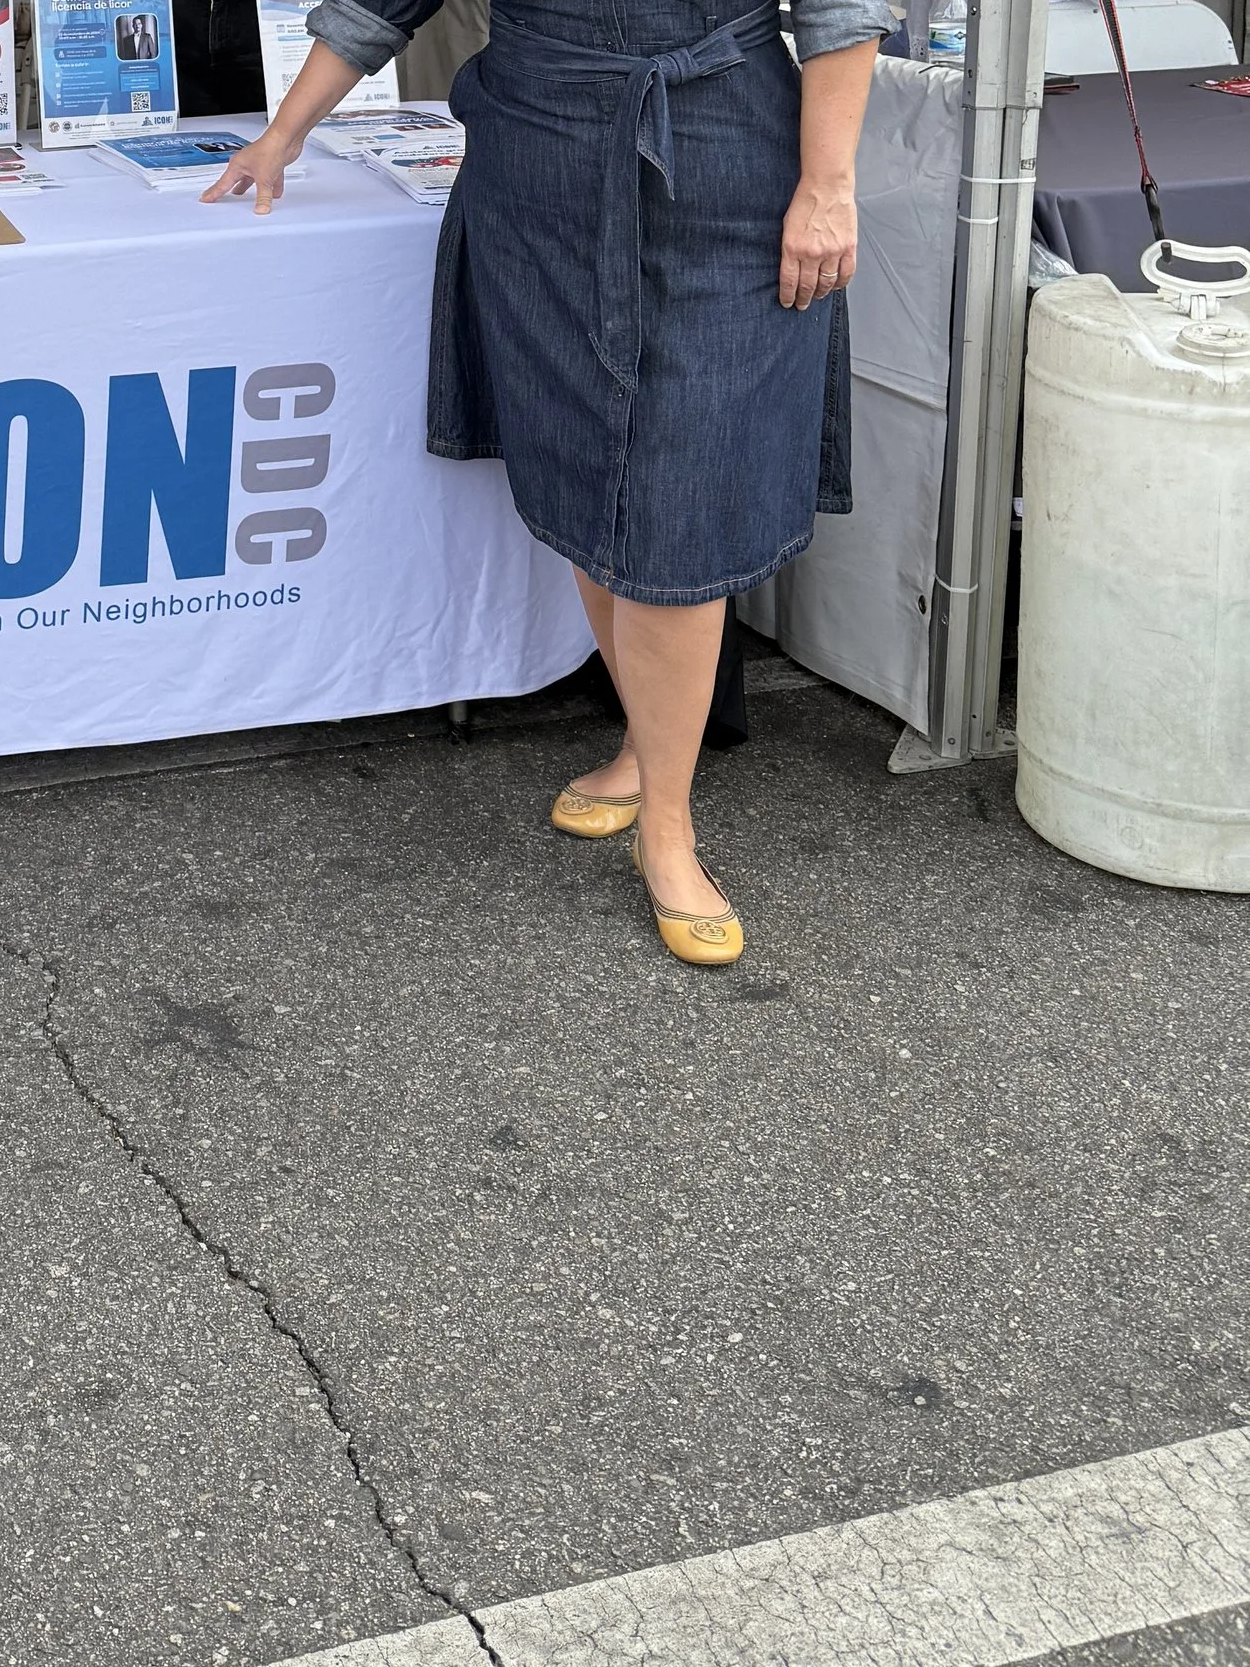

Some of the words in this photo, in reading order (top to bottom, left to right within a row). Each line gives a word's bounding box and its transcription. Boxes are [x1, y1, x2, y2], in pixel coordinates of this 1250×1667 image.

[52, 1, 91, 12] licencia
[94, 0, 107, 9] de
[109, 0, 132, 9] licor
[234, 362, 337, 566] CDC
[15, 607, 71, 631] Our
[82, 583, 303, 625] Neighborhoods
